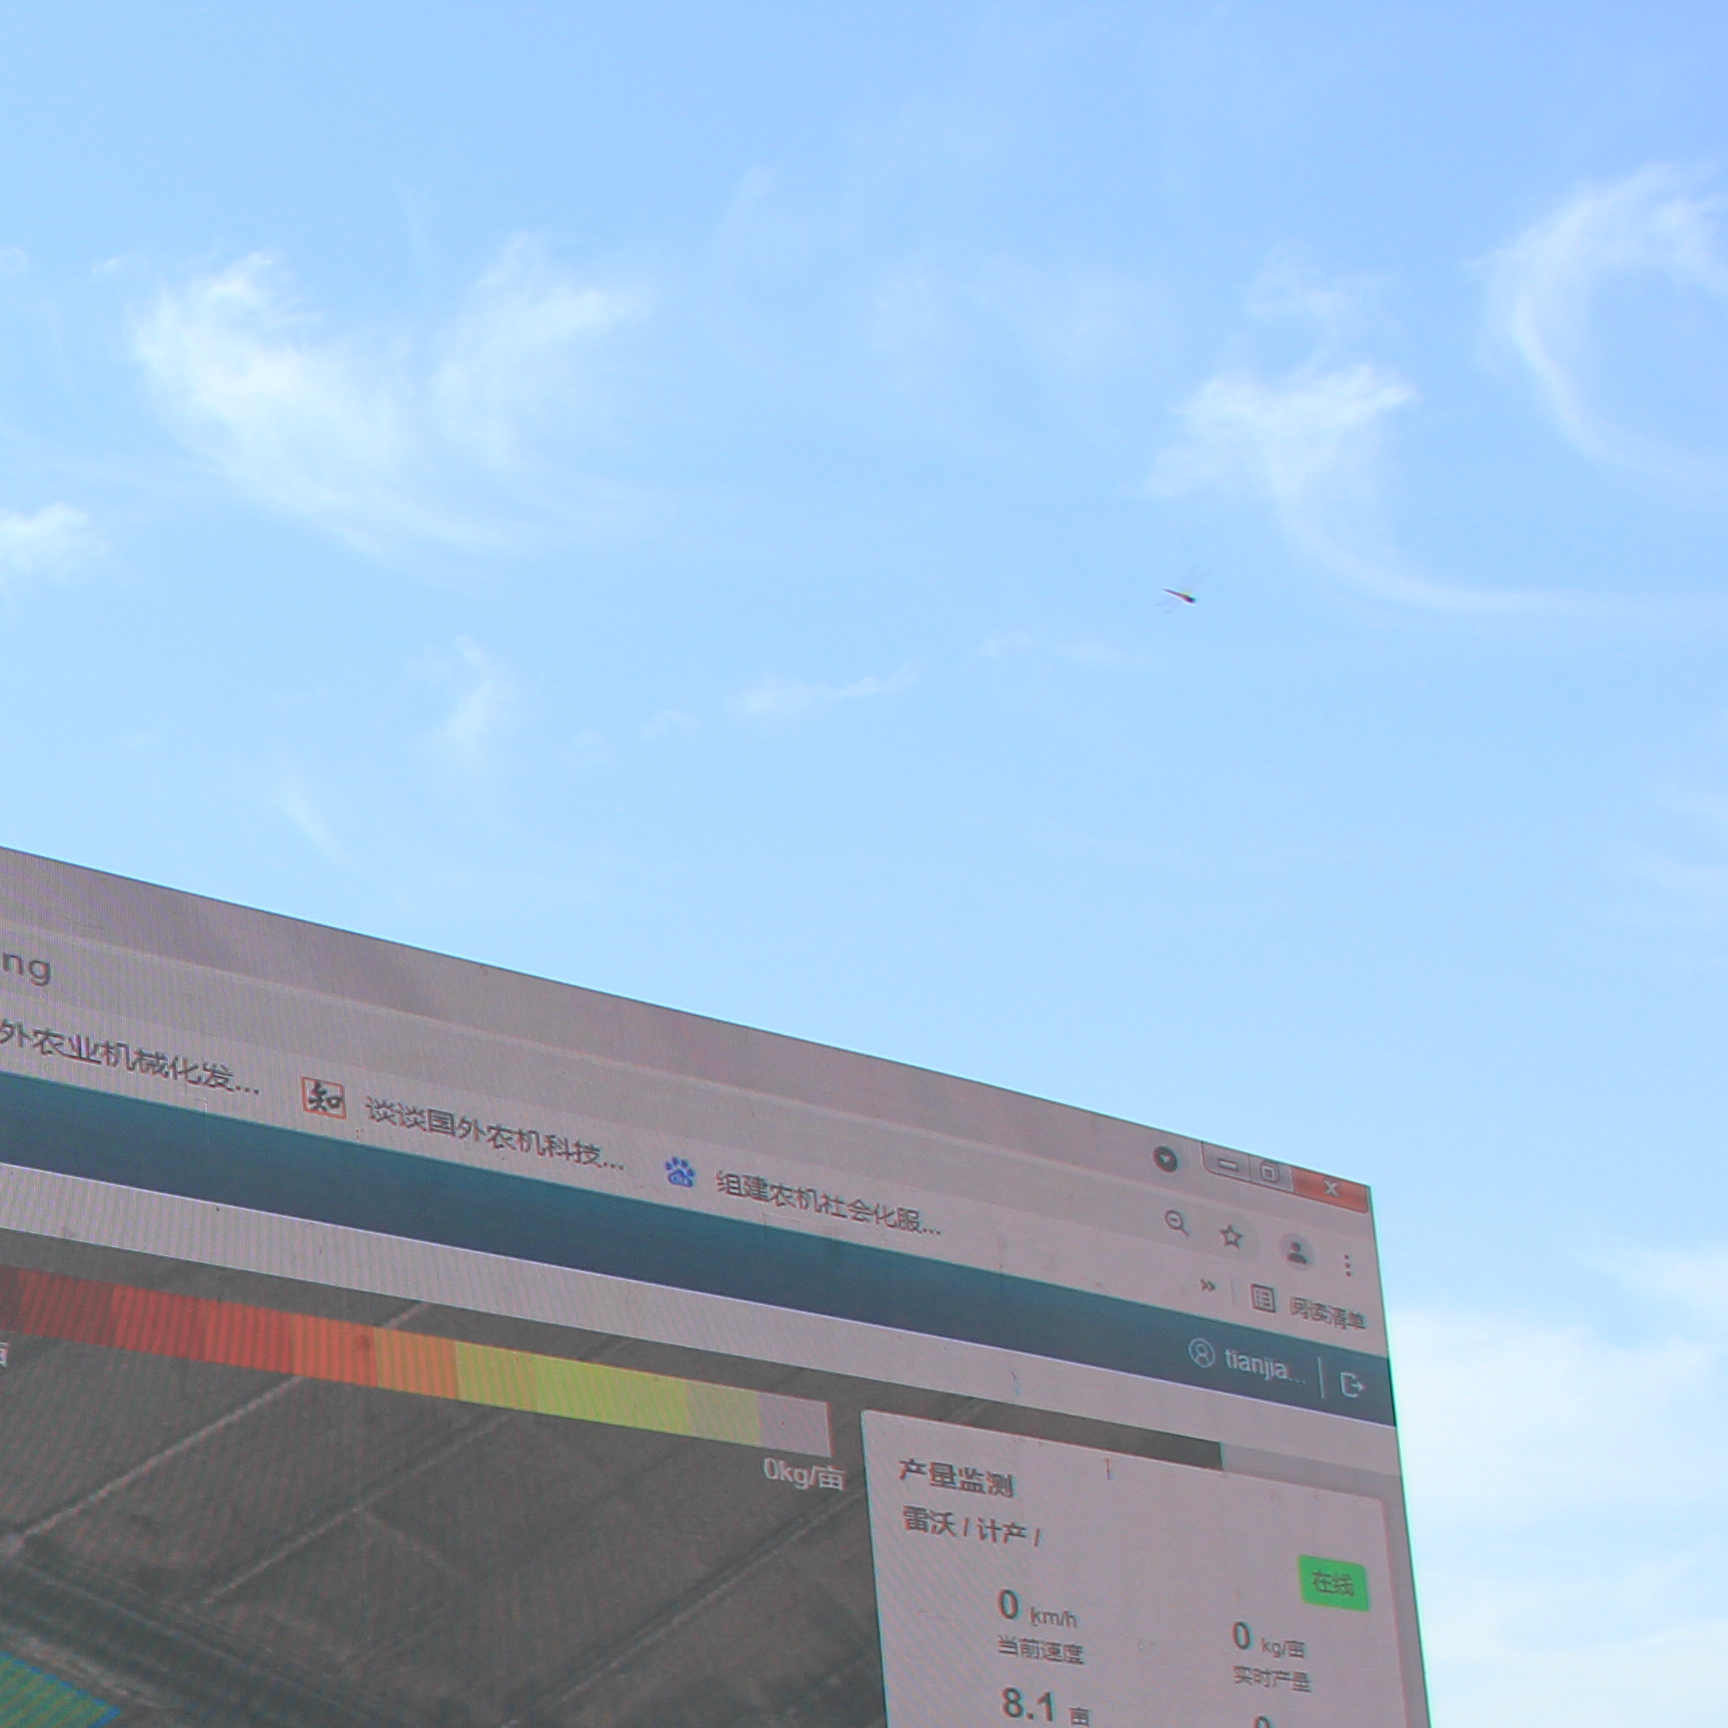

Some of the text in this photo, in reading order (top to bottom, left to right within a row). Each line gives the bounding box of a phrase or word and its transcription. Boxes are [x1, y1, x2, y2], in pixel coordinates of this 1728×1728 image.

[763, 1457, 845, 1491] 0kg/亩
[899, 1458, 1013, 1498] 产量监测
[998, 1588, 1078, 1629] 0 km/h
[998, 1634, 1085, 1665] 当前速度
[1232, 1621, 1251, 1650] 0
[1232, 1665, 1312, 1693] 实时产量
[1002, 1687, 1091, 1727] 8.1 亩
